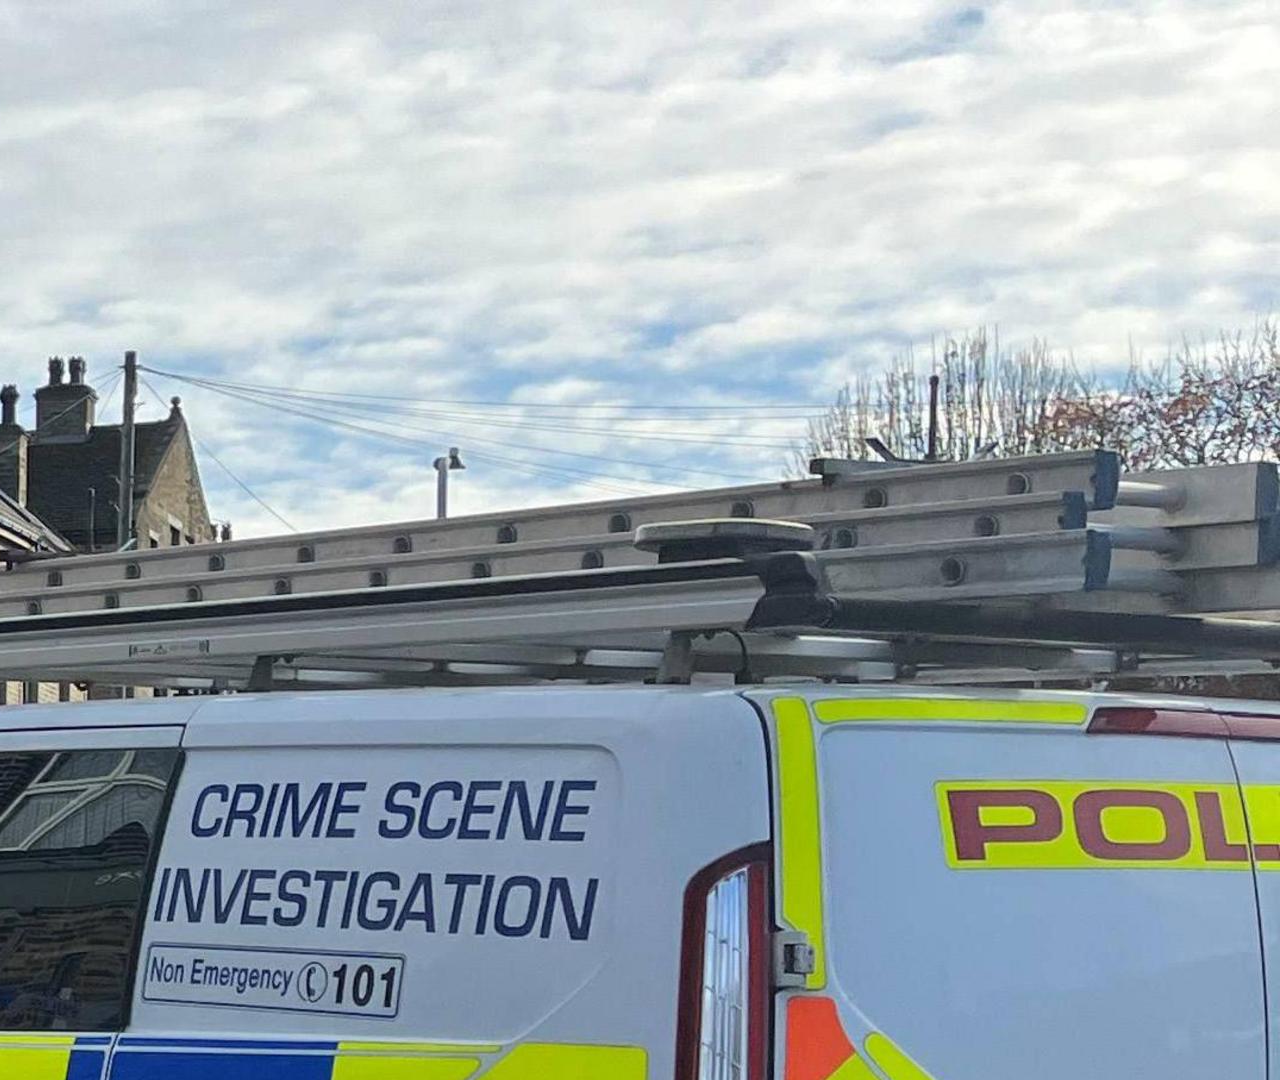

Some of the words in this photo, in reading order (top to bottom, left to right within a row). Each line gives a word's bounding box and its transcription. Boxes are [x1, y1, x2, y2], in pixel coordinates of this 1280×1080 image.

[191, 782, 366, 839] CRIME
[378, 780, 597, 842] SCENE
[153, 867, 599, 942] INVESTIGATION
[149, 956, 185, 984] Non
[191, 959, 295, 994] Emergency
[333, 963, 398, 1009] 101
